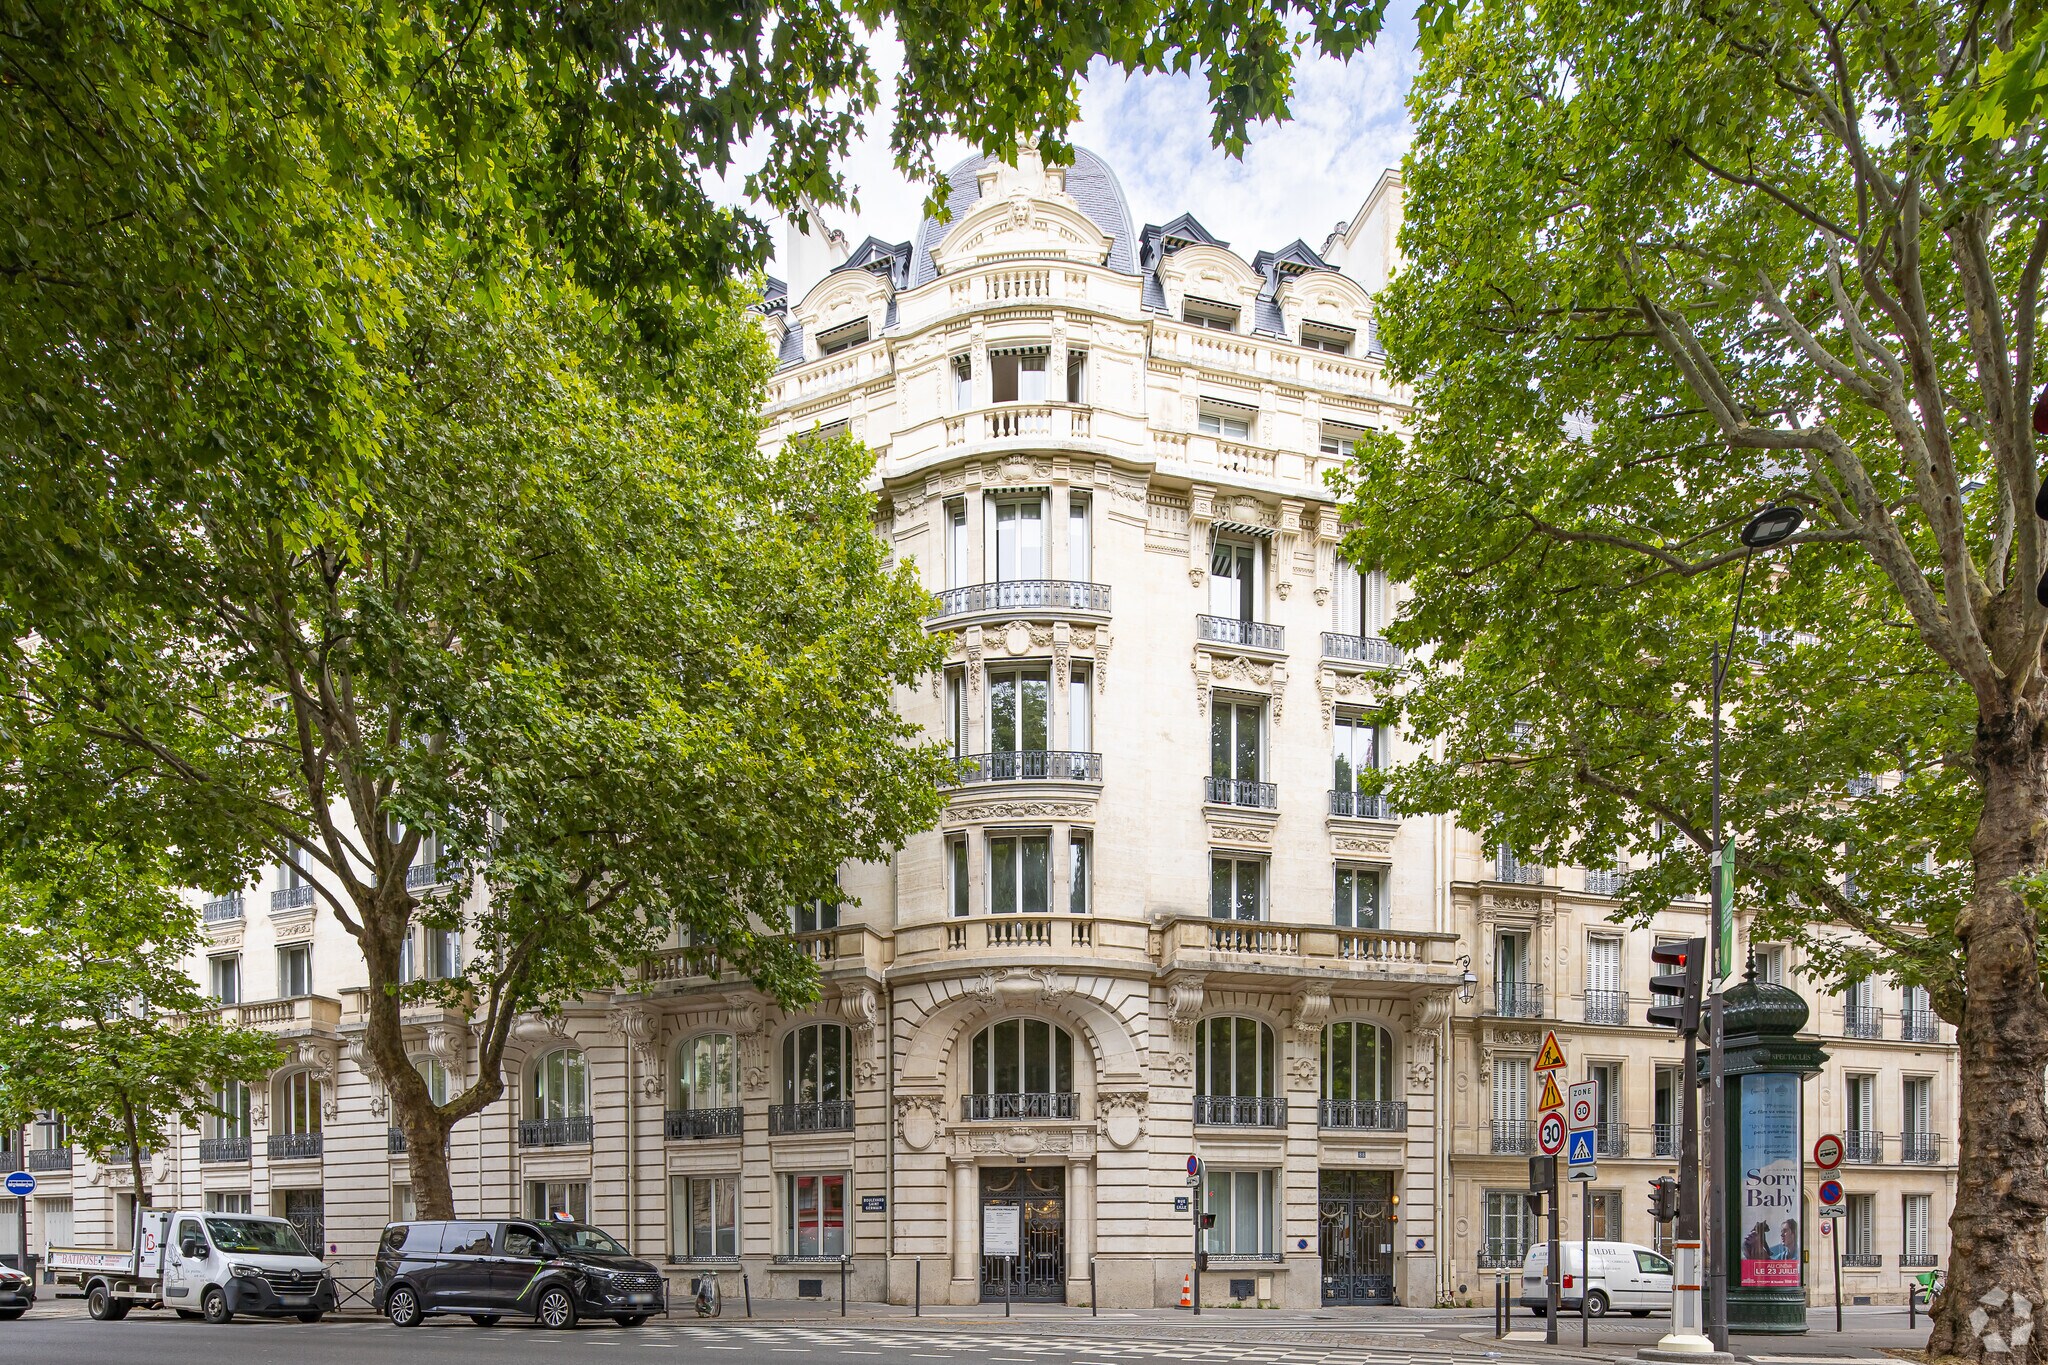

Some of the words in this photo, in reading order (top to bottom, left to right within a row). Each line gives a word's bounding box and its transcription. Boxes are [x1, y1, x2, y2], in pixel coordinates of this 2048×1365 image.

[1573, 1088, 1591, 1097] ZONE
[1577, 1107, 1587, 1116] 30
[1543, 1123, 1560, 1145] 30
[1746, 1189, 1794, 1213] Baby
[62, 1253, 98, 1265] BATIPOSE
